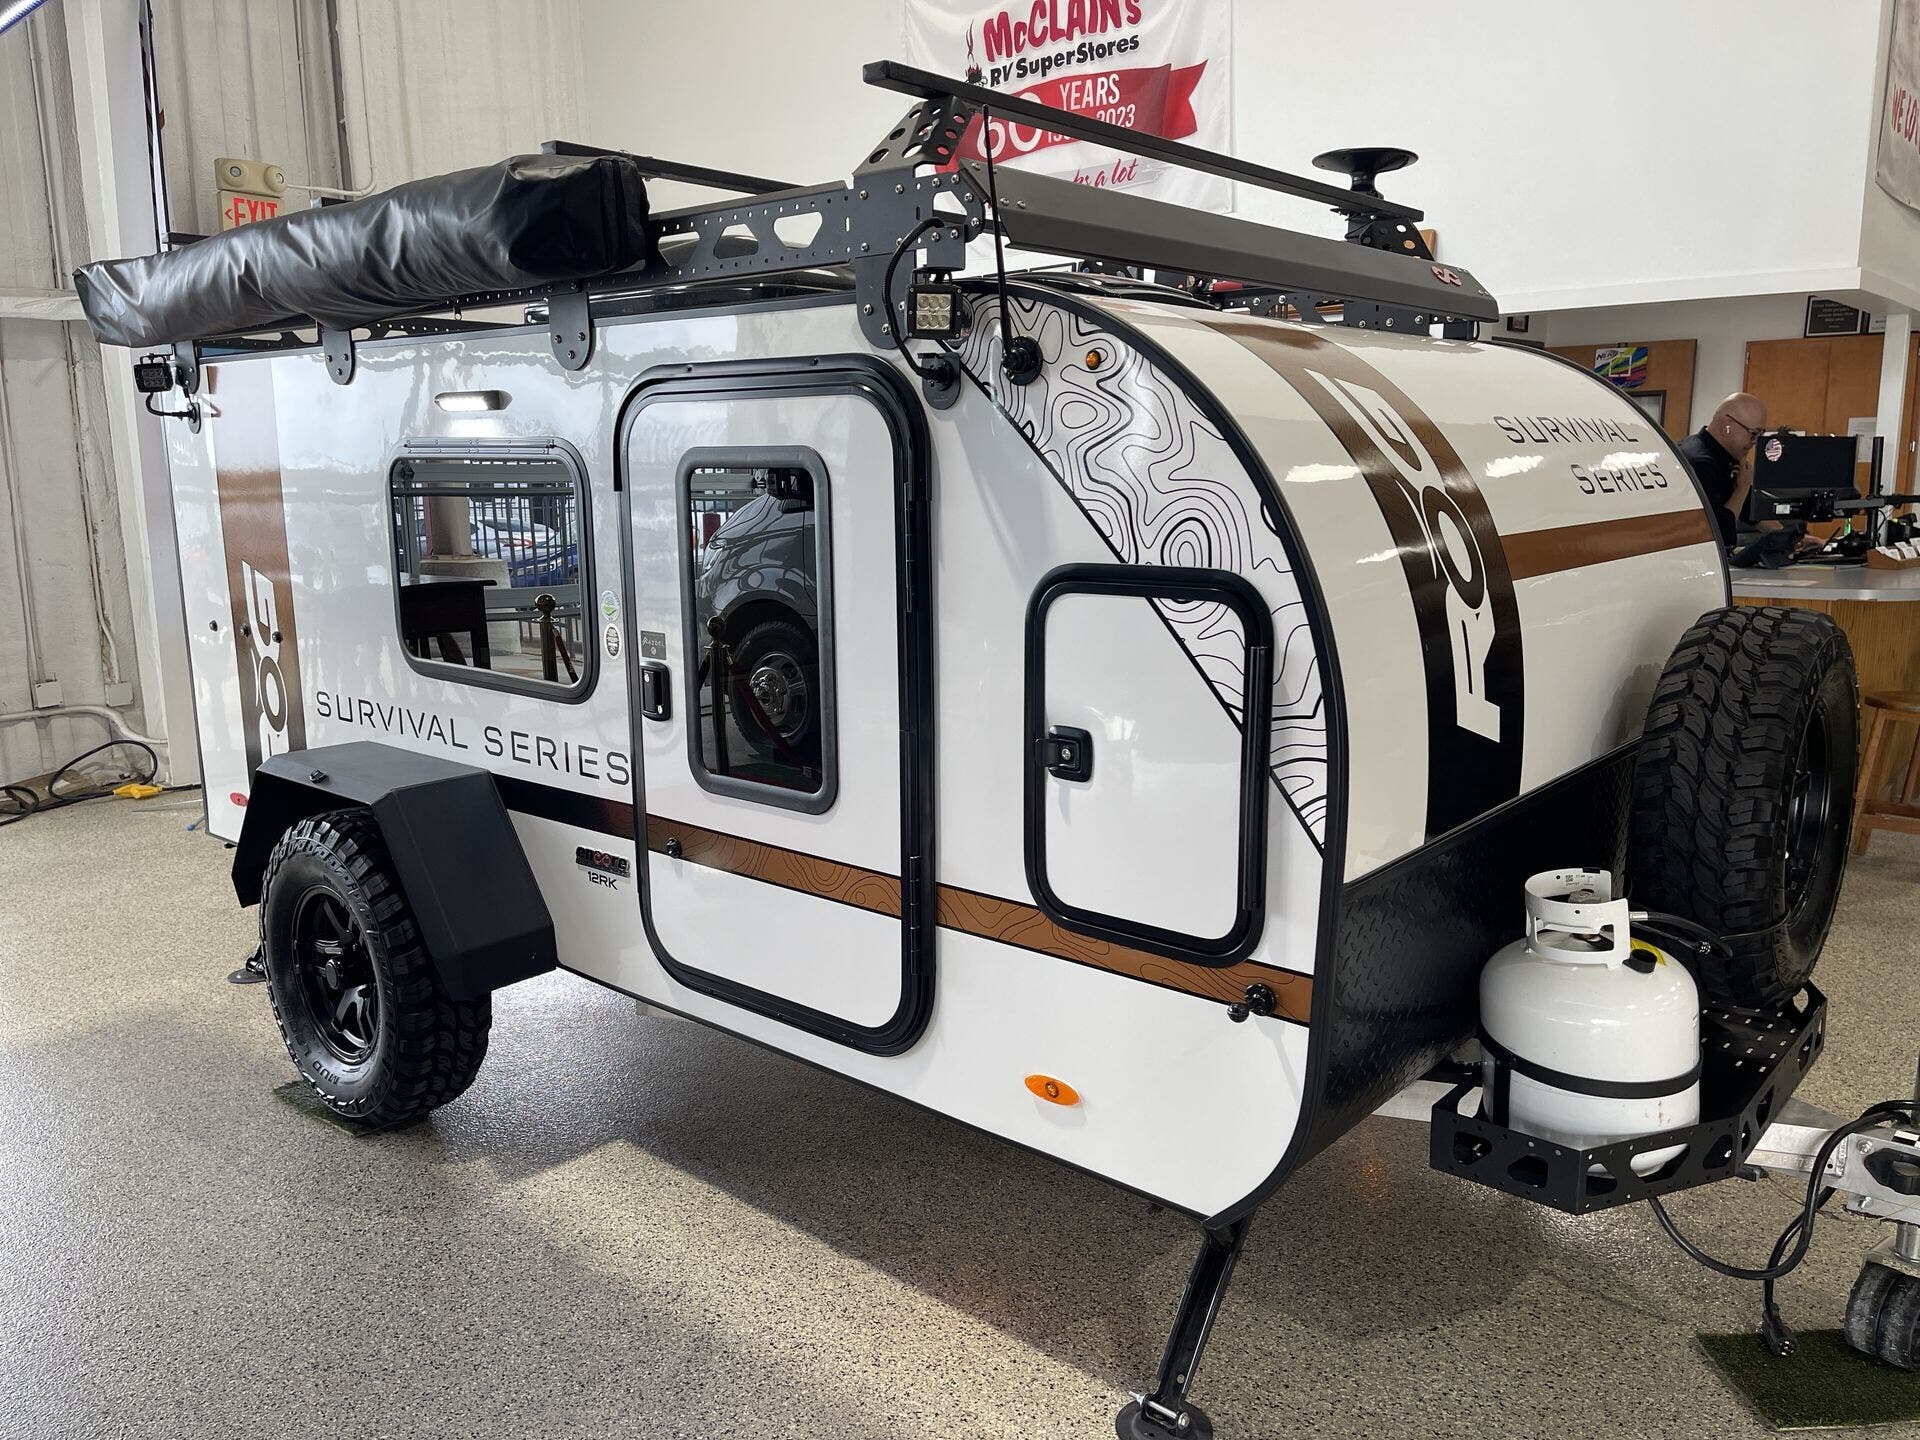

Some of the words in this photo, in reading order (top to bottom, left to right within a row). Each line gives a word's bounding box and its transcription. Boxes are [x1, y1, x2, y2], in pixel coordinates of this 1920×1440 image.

[990, 61, 1014, 88] RV
[1016, 34, 1140, 77] SuperStores
[1059, 73, 1121, 111] YEARS
[1111, 158, 1139, 183] lot
[1493, 416, 1639, 444] SURVIVAL
[1570, 463, 1668, 495] SERIES
[316, 690, 469, 750] SURVIVAL
[483, 725, 631, 786] SERIES
[587, 870, 618, 890] 12RK
